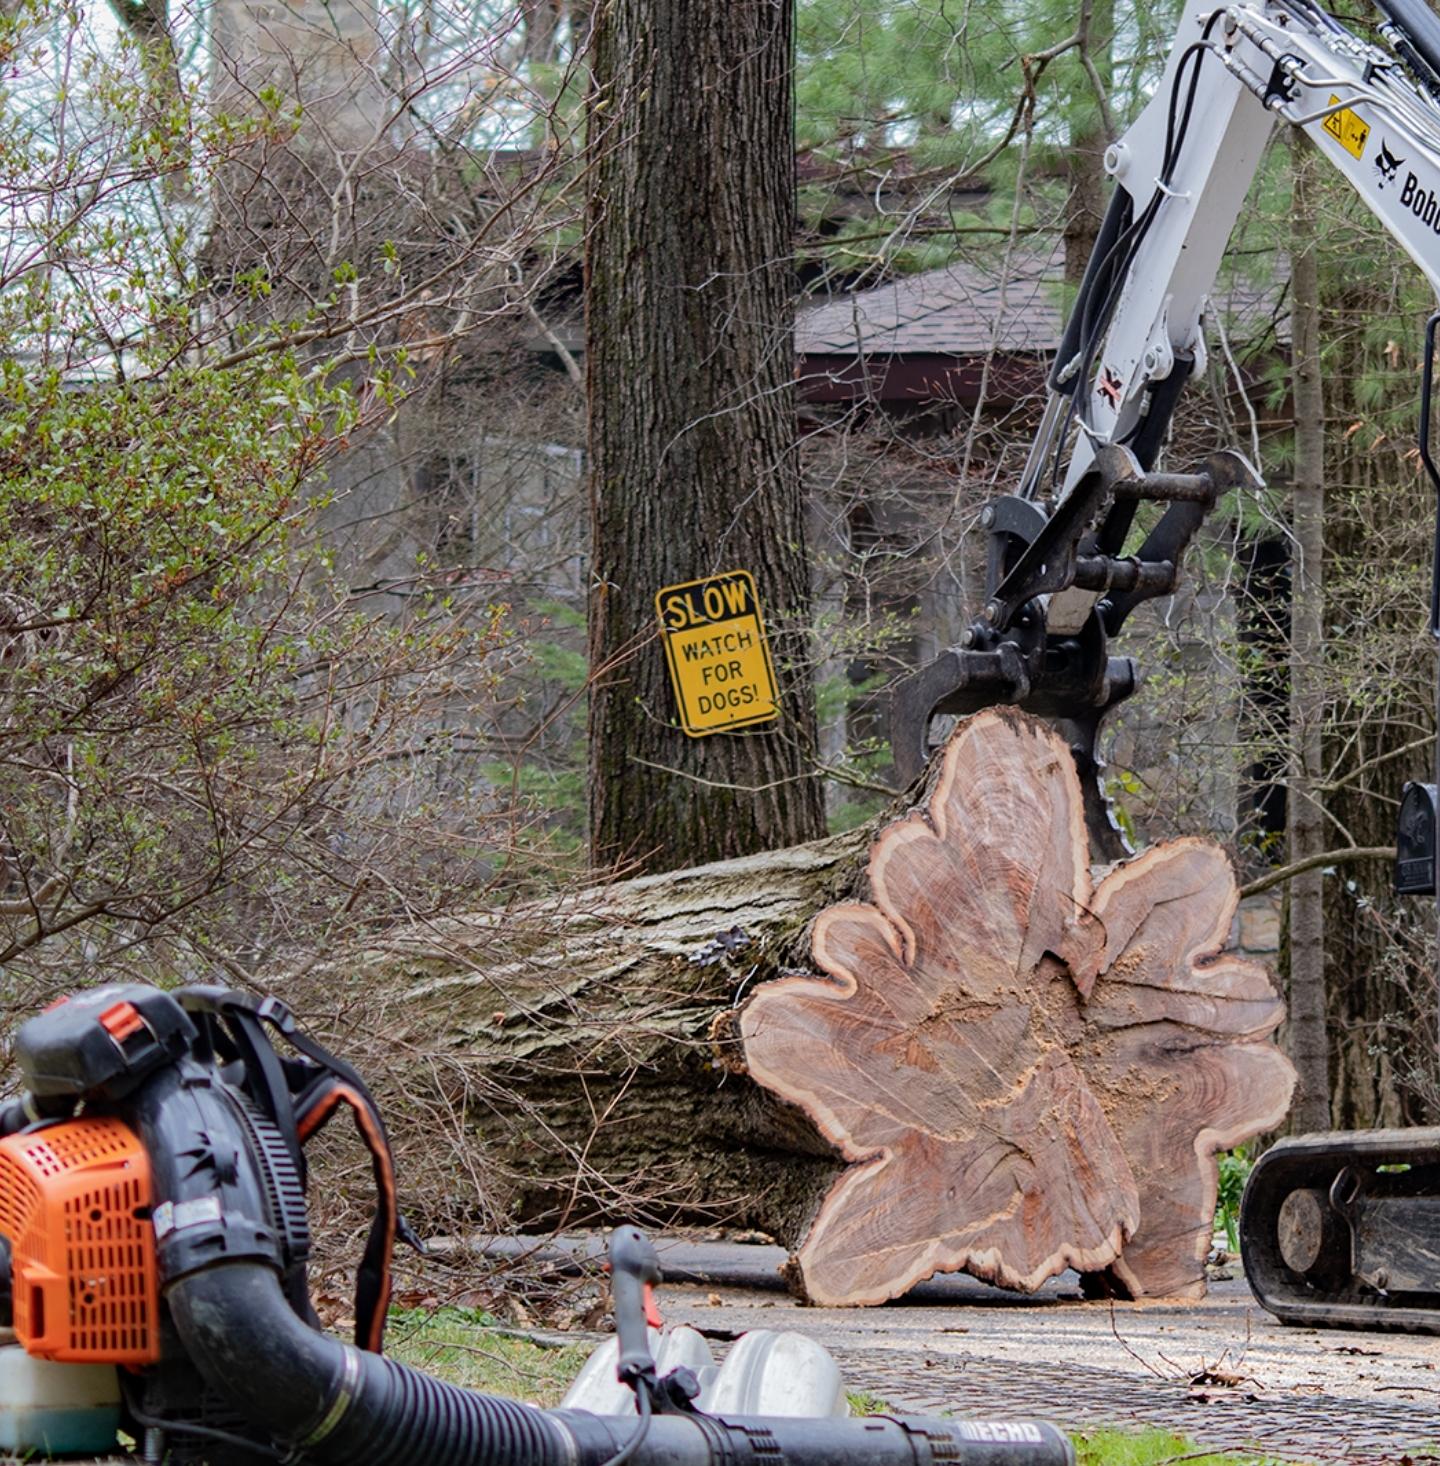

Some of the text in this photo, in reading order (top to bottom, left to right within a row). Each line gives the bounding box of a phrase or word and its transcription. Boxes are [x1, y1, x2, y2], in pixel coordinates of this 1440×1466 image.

[667, 580, 746, 628] SLOW
[682, 632, 752, 663] WATCH
[702, 660, 744, 686] FOR
[698, 684, 760, 715] DOGS!
[974, 1421, 1043, 1442] ECHO
